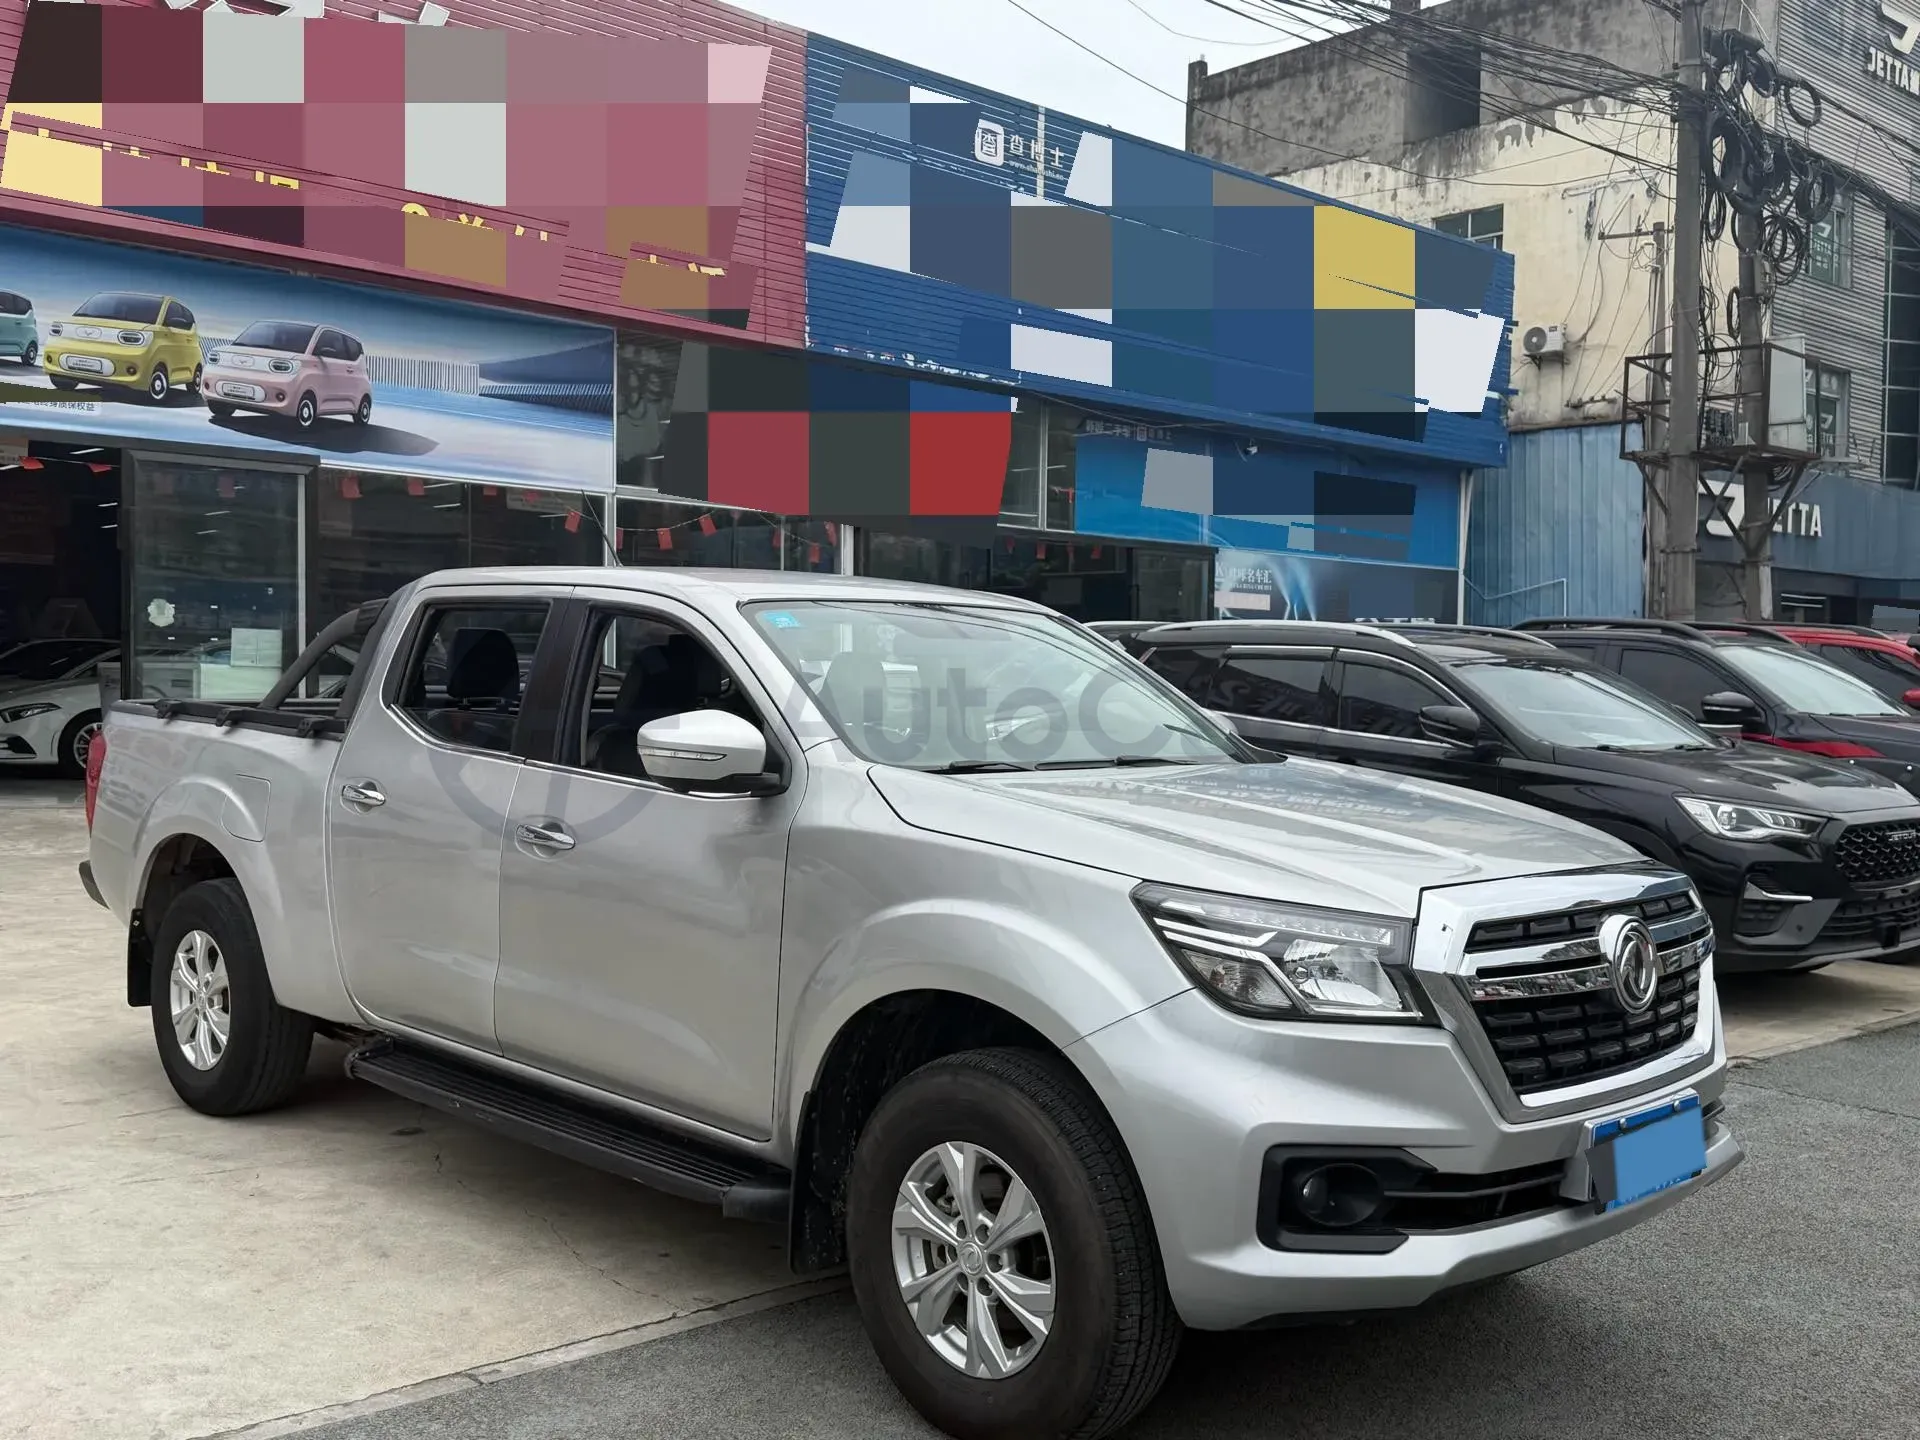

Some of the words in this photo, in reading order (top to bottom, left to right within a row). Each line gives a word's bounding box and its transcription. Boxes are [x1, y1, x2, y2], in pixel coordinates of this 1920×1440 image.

[1867, 46, 1909, 91] JETTA
[1009, 134, 1064, 168] 查博士
[1767, 497, 1822, 537] ETTA
